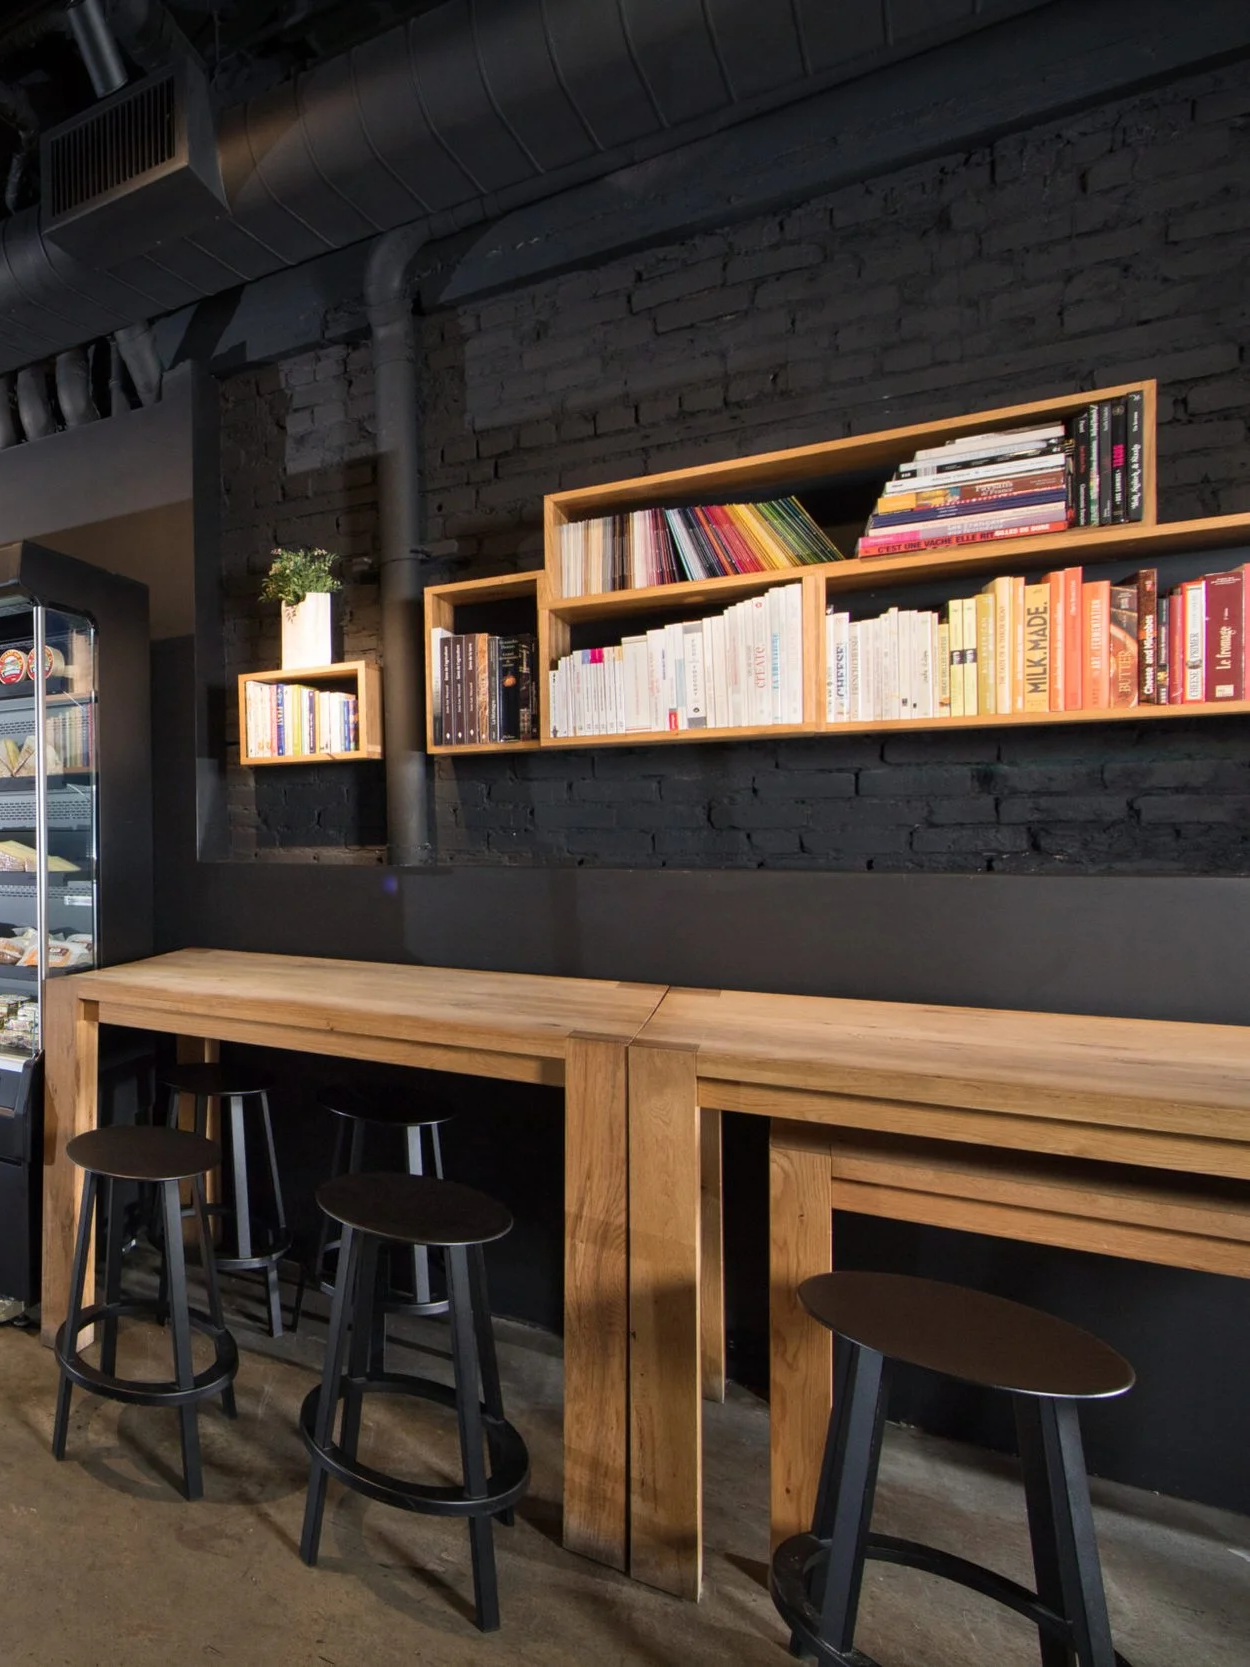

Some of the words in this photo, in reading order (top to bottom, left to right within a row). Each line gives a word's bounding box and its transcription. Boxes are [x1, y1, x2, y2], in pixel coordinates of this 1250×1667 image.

[1113, 444, 1125, 468] TACOS
[878, 544, 903, 553] C'EST
[904, 542, 922, 550] UNE
[924, 538, 952, 547] VACHE
[956, 533, 977, 542] ELLE
[1141, 615, 1155, 649] Microbes
[1188, 632, 1200, 659] PRIMER
[1215, 626, 1237, 658] fromage
[1143, 649, 1153, 664] and
[1215, 659, 1232, 670] Le
[836, 646, 845, 697] CHEESE
[1118, 649, 1132, 693] BUTTER
[1143, 667, 1154, 695] Cheese
[1188, 671, 1200, 698] CHEESE
